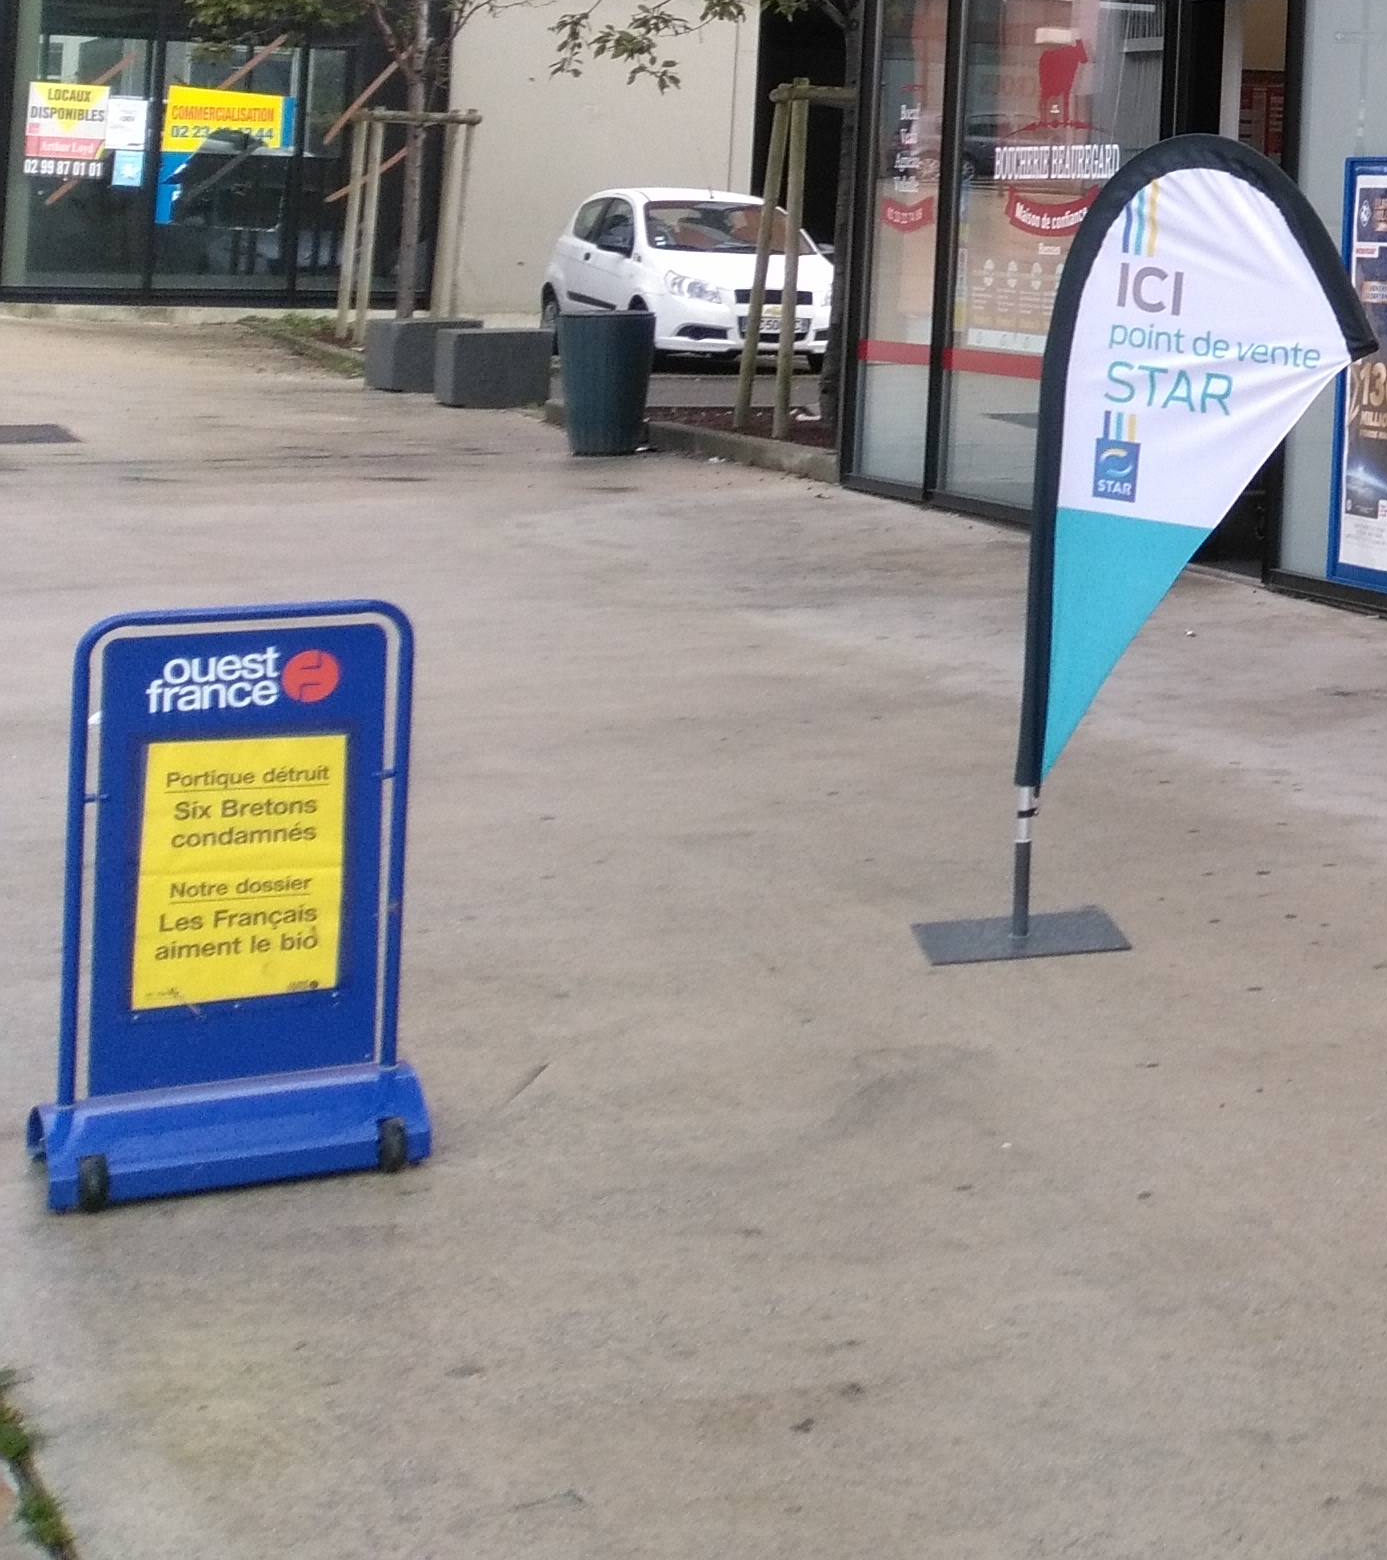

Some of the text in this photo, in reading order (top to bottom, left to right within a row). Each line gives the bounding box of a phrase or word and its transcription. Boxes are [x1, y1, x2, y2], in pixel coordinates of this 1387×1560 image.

[47, 88, 92, 102] LOCAUX
[29, 106, 105, 122] DISPONIBLES
[171, 105, 274, 122] COMMERCIALISATION
[171, 125, 188, 138] 02
[41, 141, 94, 155] Arthur Loyd
[23, 159, 102, 176] 02 99 87 01 01
[993, 144, 1120, 180] BOUCHERIE BEAUREGARD
[1015, 202, 1042, 227] Maison
[1042, 215, 1051, 229] de
[1117, 262, 1184, 316] ICI
[1109, 322, 1320, 369] point de vente
[1104, 360, 1234, 416] STAR
[1097, 479, 1132, 496] STAR
[164, 645, 280, 686] ouest
[145, 672, 280, 714] france
[165, 764, 329, 791] Portique détruit
[173, 797, 318, 821] Six Bretons
[170, 822, 317, 849] condamnés
[169, 875, 312, 899] Notre dossier
[159, 904, 318, 933] Les Français
[155, 930, 319, 961] aiment le bio
